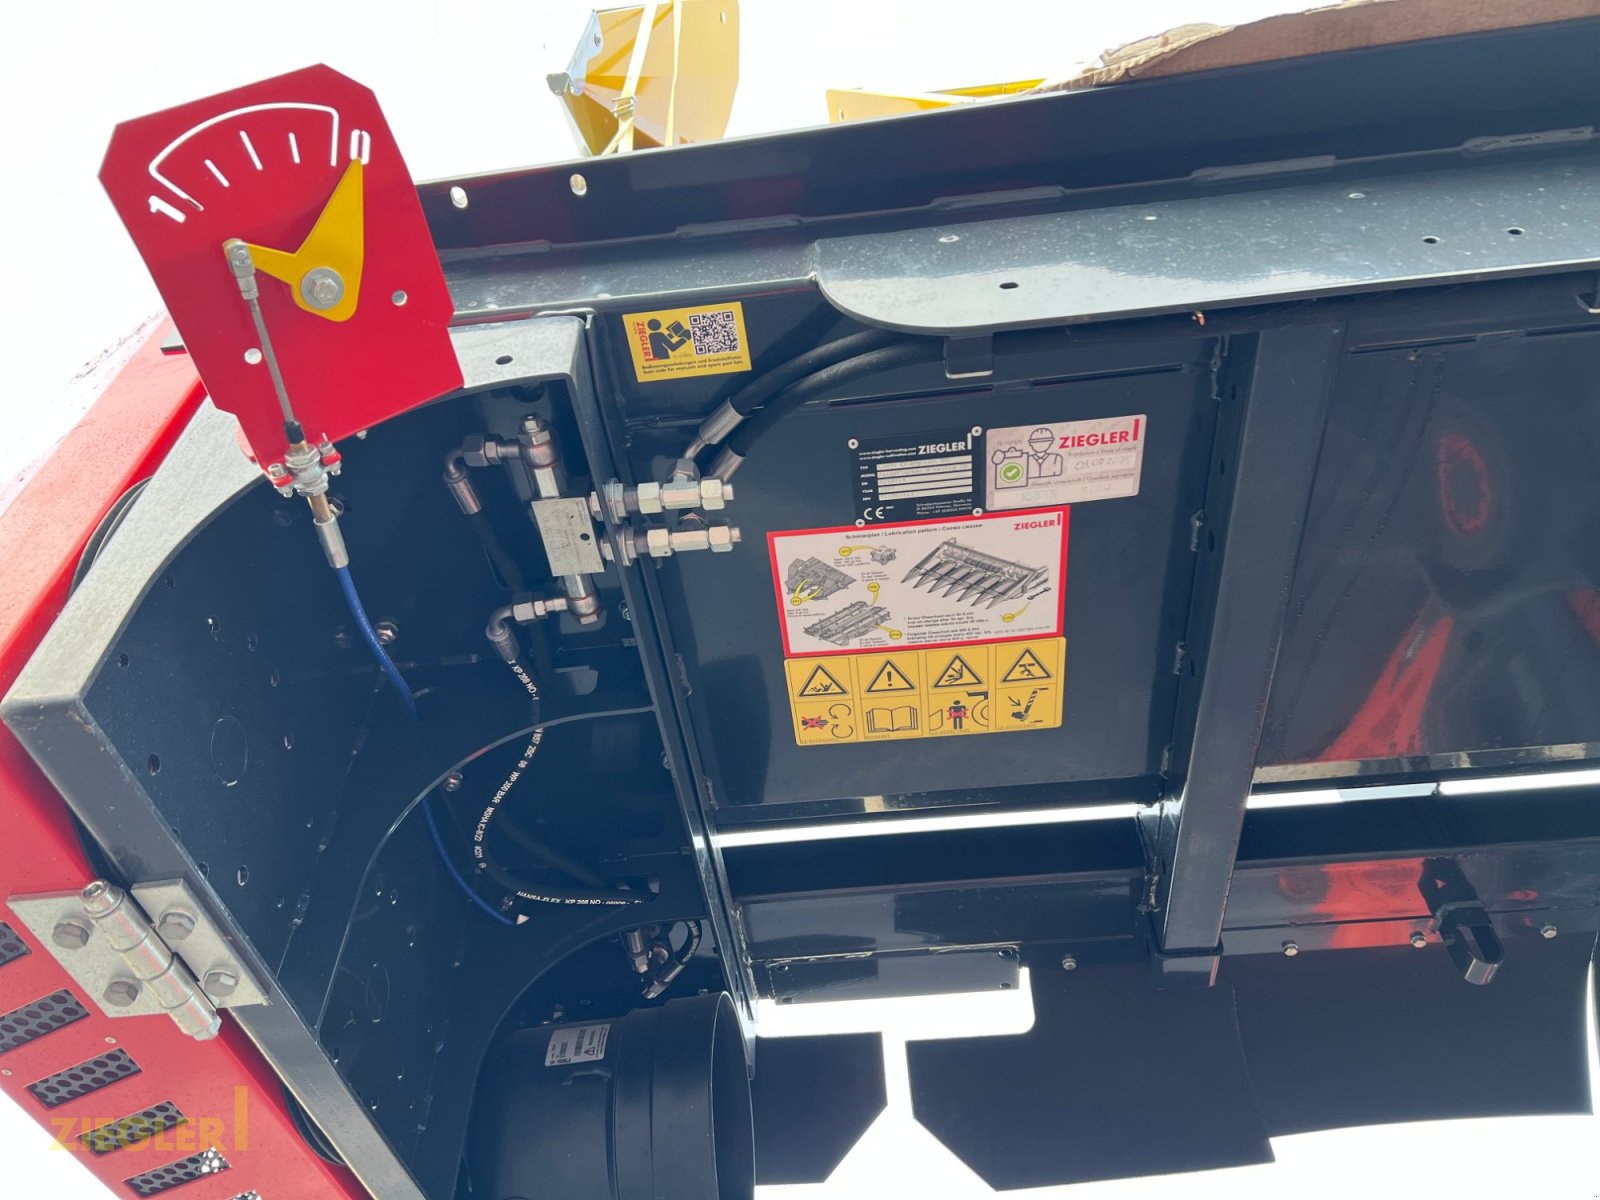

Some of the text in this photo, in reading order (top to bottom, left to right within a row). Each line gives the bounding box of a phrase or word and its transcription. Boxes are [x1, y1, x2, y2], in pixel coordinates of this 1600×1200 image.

[148, 195, 187, 224] 1
[636, 320, 651, 359] ZIEGLER
[1058, 430, 1129, 449] ZIEGLER
[918, 441, 966, 455] ZIEGLER
[1013, 519, 1056, 531] ZIEGLER
[885, 529, 917, 537] Lubrication
[525, 682, 537, 693] NO
[509, 771, 521, 782] WP
[501, 780, 513, 791] 350
[492, 790, 506, 804] BAR
[481, 806, 495, 821] MSHA
